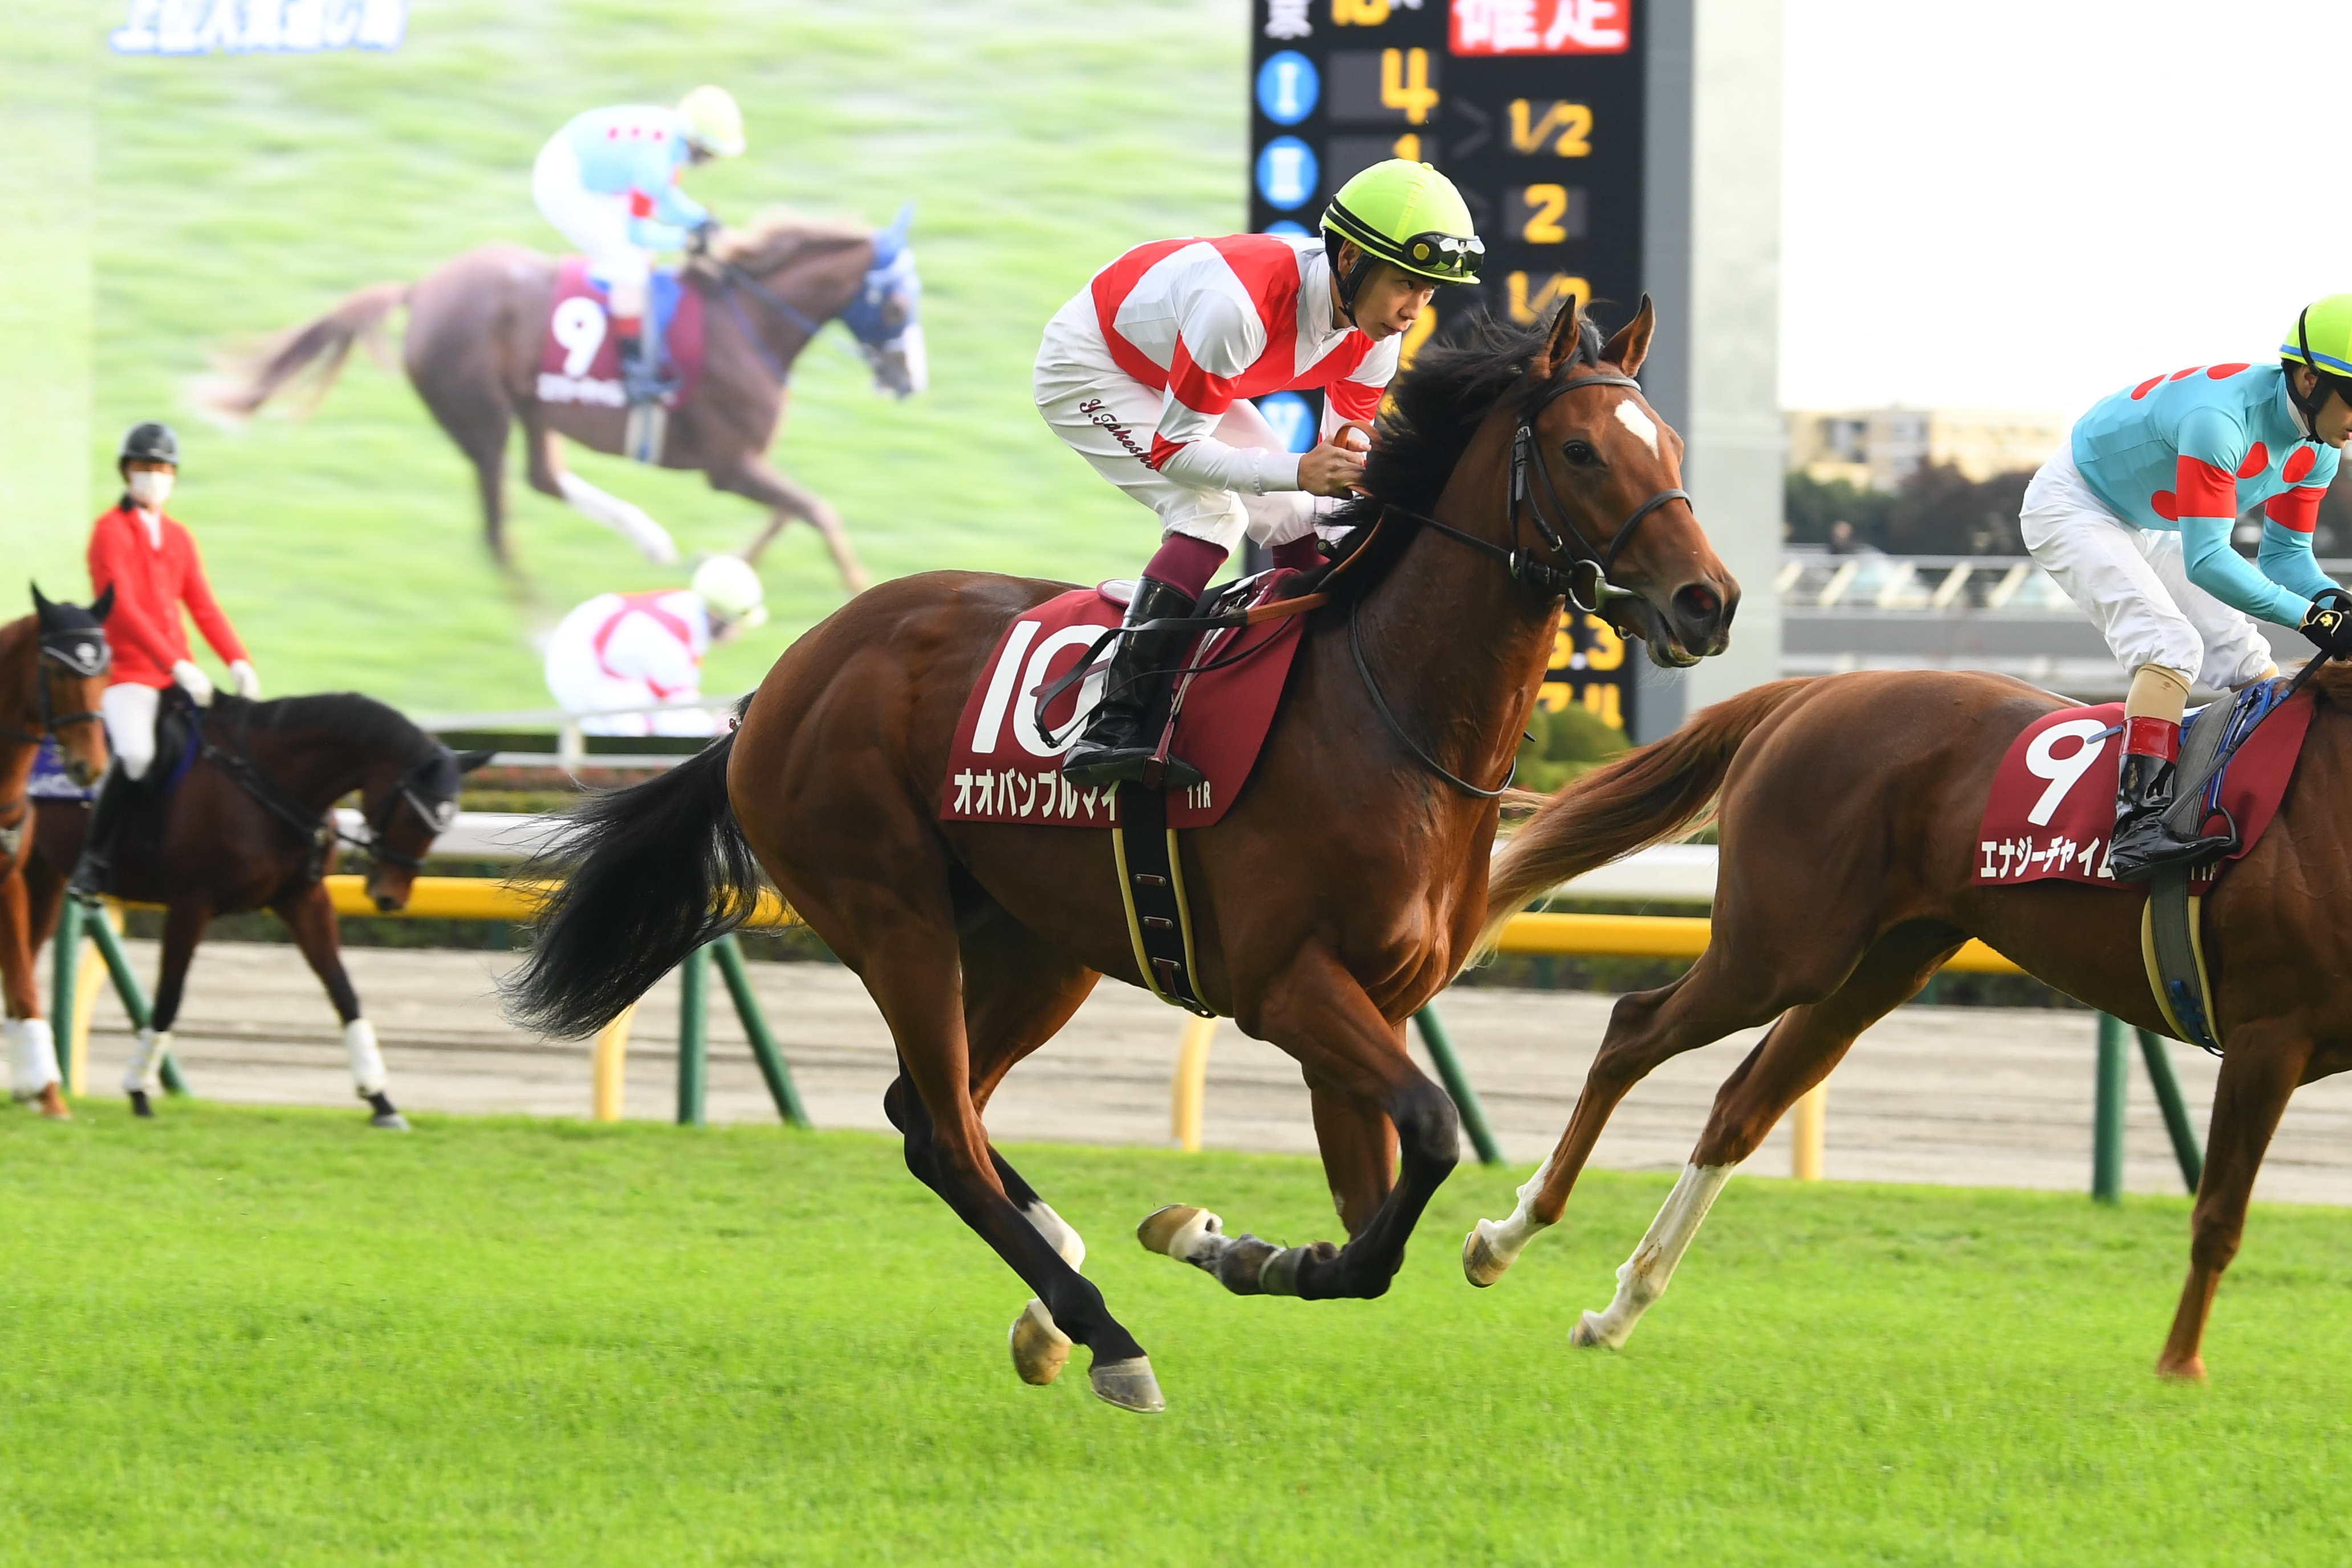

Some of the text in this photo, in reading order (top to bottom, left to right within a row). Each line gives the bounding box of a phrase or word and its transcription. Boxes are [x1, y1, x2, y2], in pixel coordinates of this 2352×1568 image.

[1382, 48, 1440, 124] 4
[1509, 99, 1593, 157] 1/2
[1524, 184, 1567, 243] 2
[551, 296, 607, 377] 9
[972, 621, 1110, 757] 10
[1187, 781, 1211, 809] 11R
[2025, 719, 2107, 826] 9
